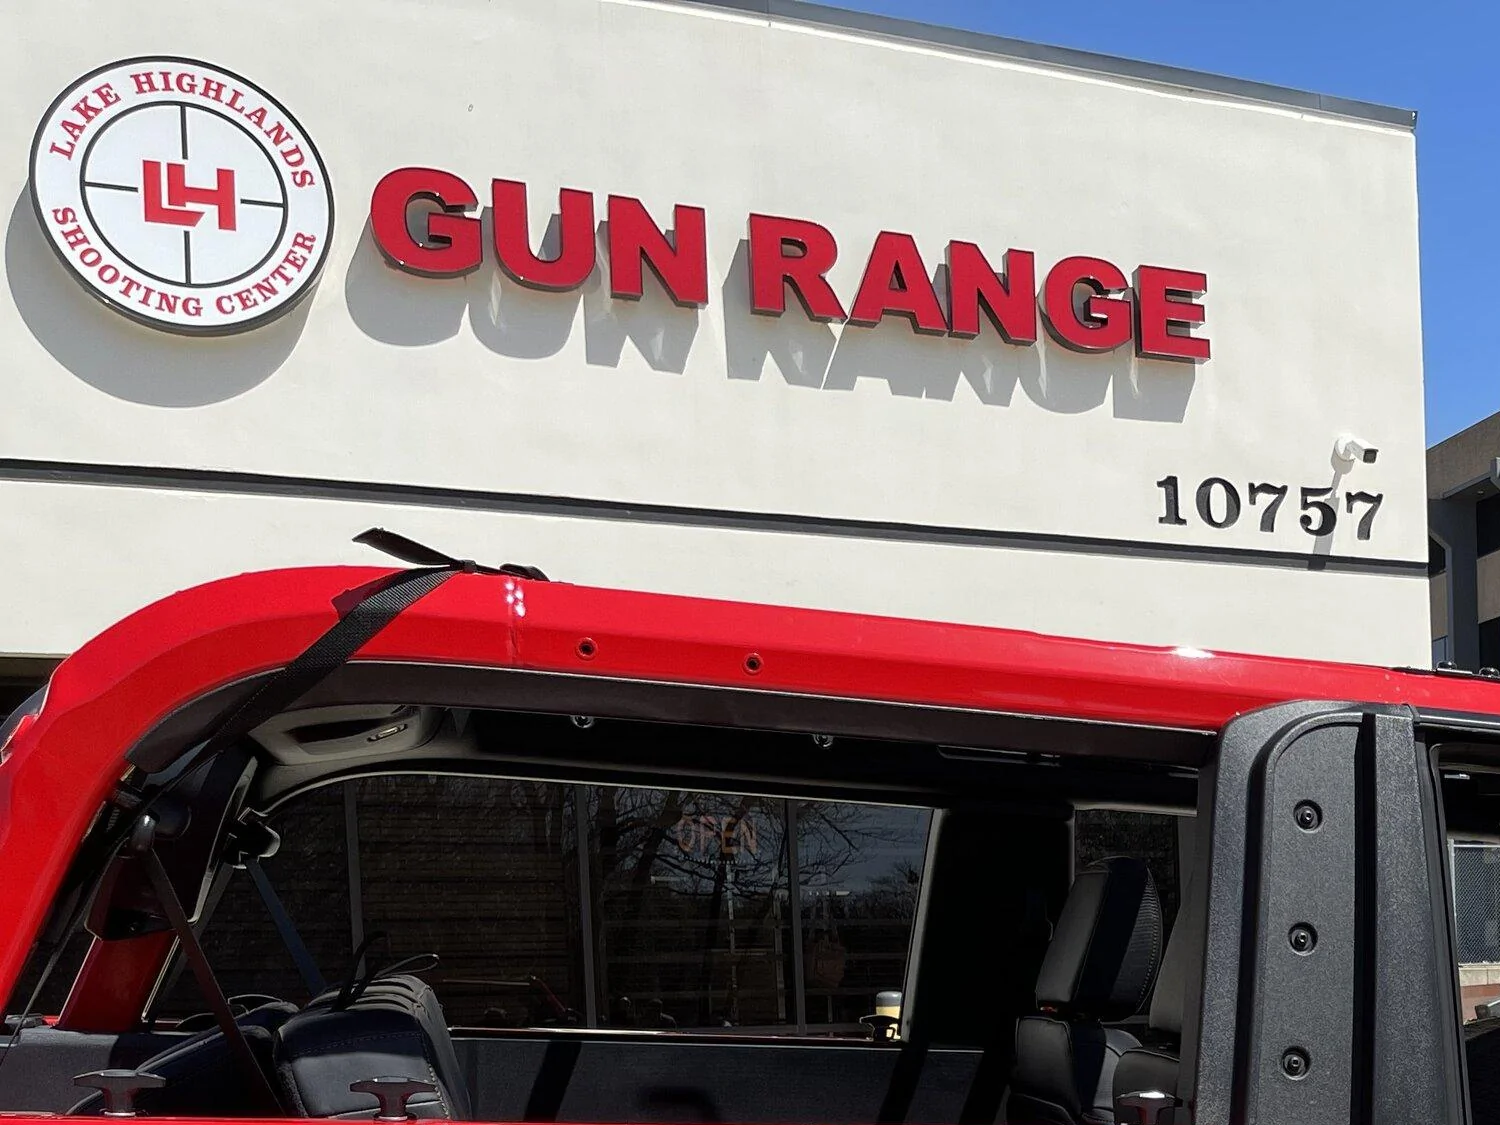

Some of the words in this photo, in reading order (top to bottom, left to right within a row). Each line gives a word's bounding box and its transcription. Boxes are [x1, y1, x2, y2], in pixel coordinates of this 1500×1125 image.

[49, 83, 122, 161] LAKE
[130, 71, 315, 188] HIGHLANDS
[142, 159, 237, 232] LH
[52, 206, 203, 317] SHOOTING
[215, 231, 317, 315] CENTER
[370, 166, 709, 309] GUN
[747, 212, 1212, 365] RANGE
[1156, 475, 1384, 541] 10757
[676, 814, 759, 856] OPEN
